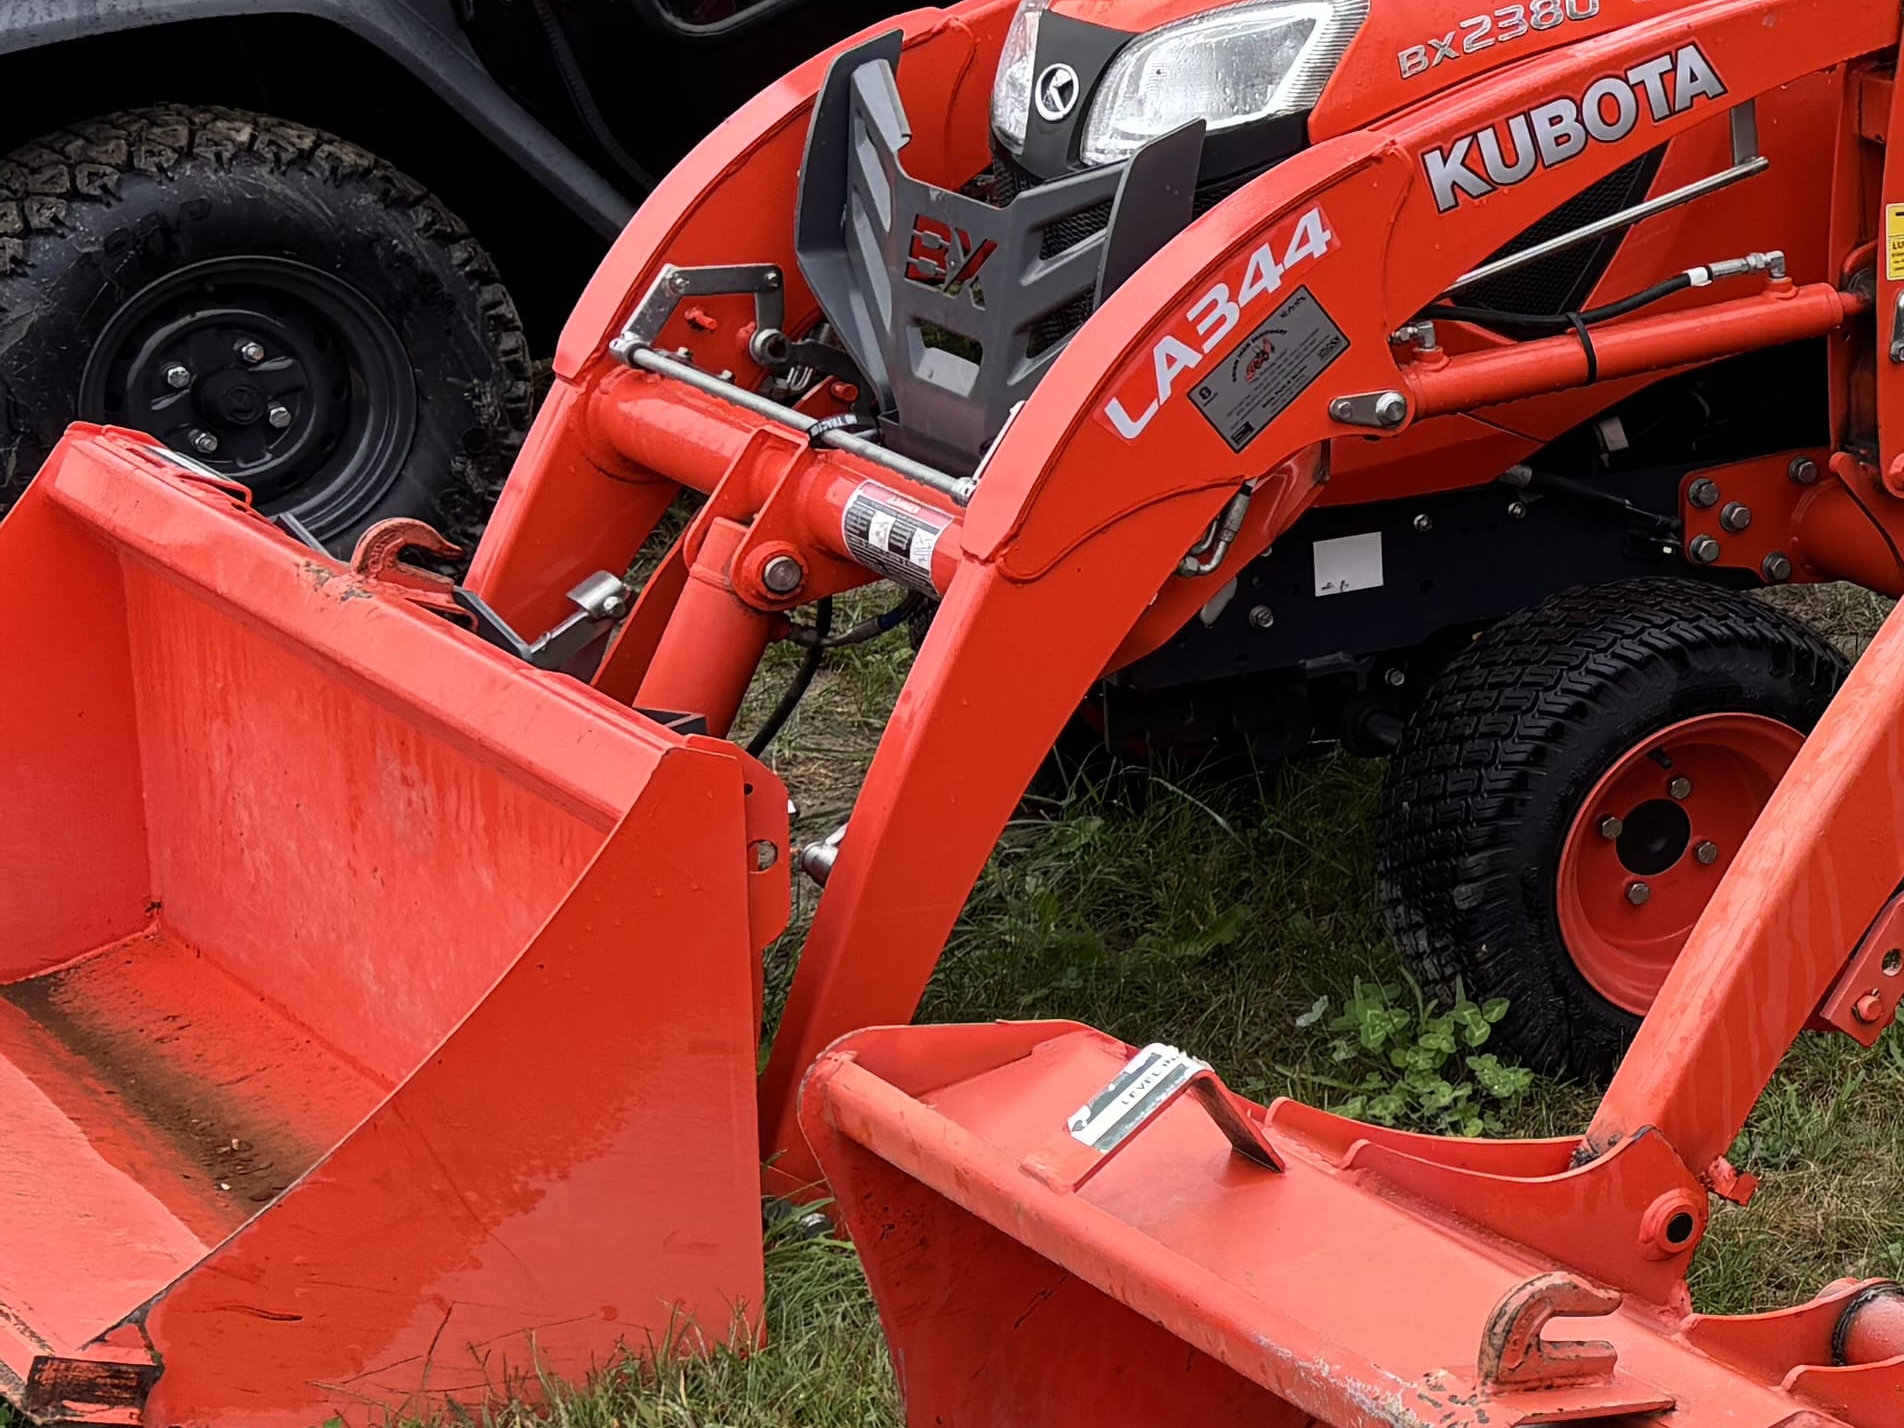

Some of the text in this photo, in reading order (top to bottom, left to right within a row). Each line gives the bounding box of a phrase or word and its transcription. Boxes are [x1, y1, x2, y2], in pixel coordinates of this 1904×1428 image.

[1422, 40, 1729, 214] KUBOTA
[904, 213, 1000, 311] BX
[1103, 207, 1332, 440] LA344
[1120, 1071, 1162, 1105] LEVEL
